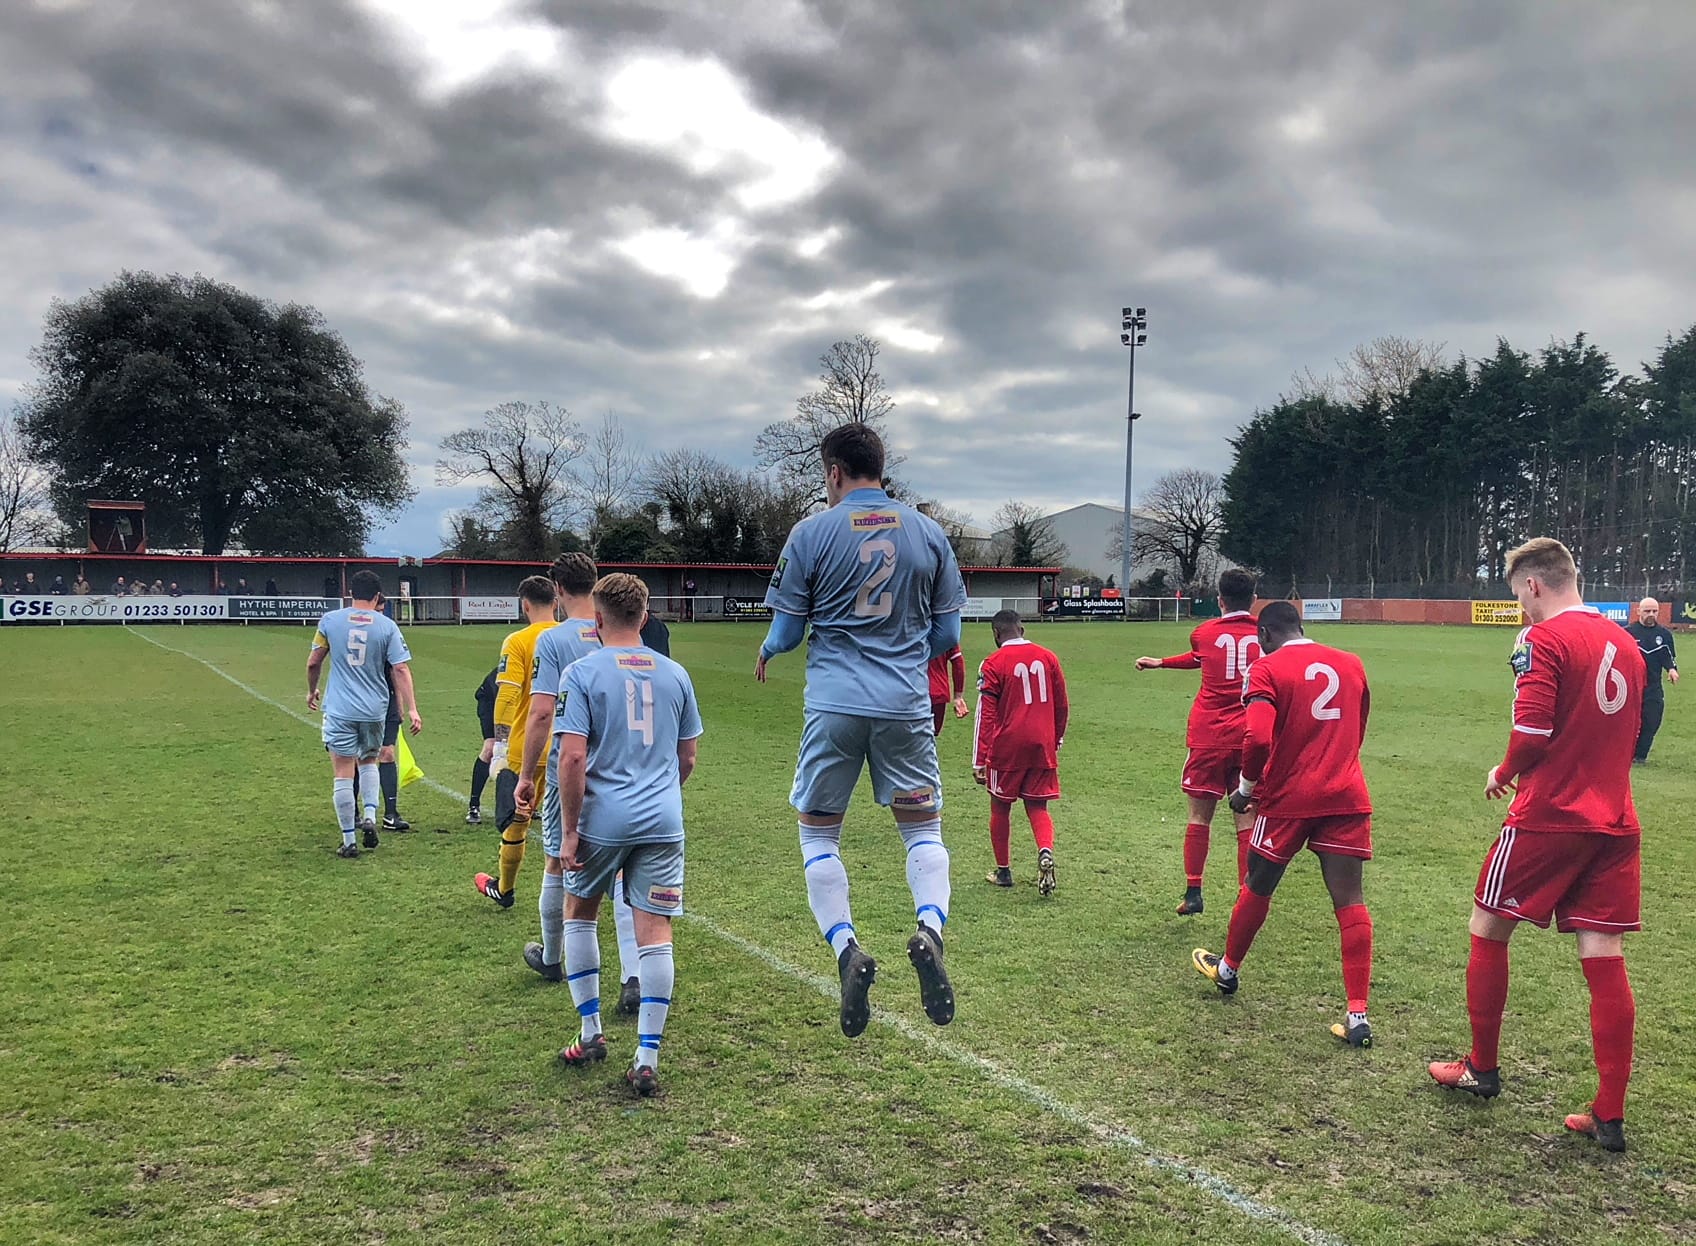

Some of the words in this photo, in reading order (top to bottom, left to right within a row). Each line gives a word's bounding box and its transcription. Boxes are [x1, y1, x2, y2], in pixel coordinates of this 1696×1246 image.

[854, 539, 896, 618] 2
[9, 600, 53, 616] GSE
[55, 605, 118, 616] GROUP
[124, 605, 169, 616] 01233
[173, 605, 224, 616] 501301
[239, 600, 276, 609] HYTHE
[278, 600, 329, 609] IMPERIAL
[1063, 599, 1082, 607] Glass
[1083, 599, 1124, 609] Splashbacks
[1474, 614, 1494, 622] 01303
[1495, 614, 1519, 623] 252000
[1607, 609, 1628, 620] HILL
[346, 628, 368, 666] 5
[1214, 633, 1266, 680] 10
[1013, 660, 1047, 705] 11
[1304, 662, 1341, 720] 2
[1595, 640, 1628, 715] 6
[624, 679, 654, 746] 4
